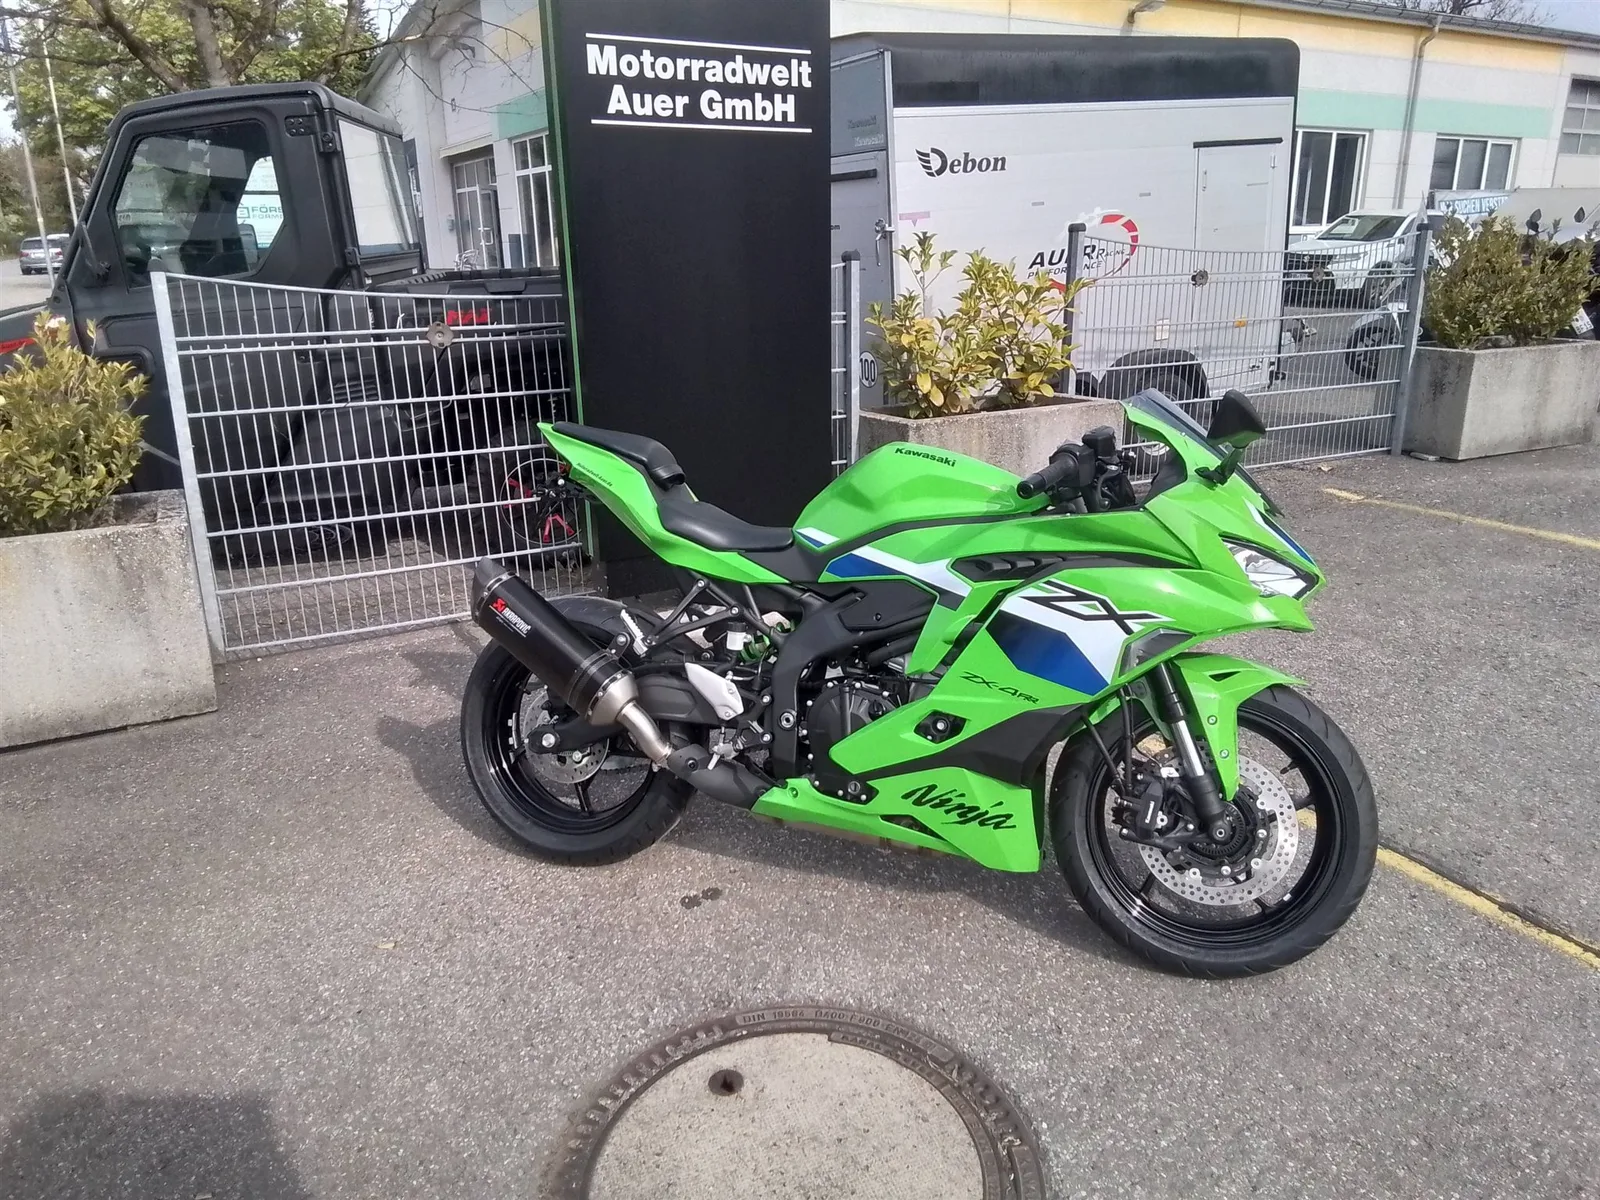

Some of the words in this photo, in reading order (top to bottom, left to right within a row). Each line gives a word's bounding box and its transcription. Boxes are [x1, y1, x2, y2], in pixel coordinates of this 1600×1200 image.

[586, 43, 812, 88] Motorradwelt
[607, 84, 689, 117] Auer
[700, 89, 795, 122] GmbH
[915, 147, 1007, 177] Debon
[1028, 244, 1097, 270] AUR
[860, 357, 876, 382] 100
[895, 447, 957, 468] Kawasaki
[1018, 579, 1163, 636] ZX
[959, 670, 1040, 705] ZX-4RR
[901, 783, 1017, 830] Ninja
[742, 1012, 766, 1024] DIN
